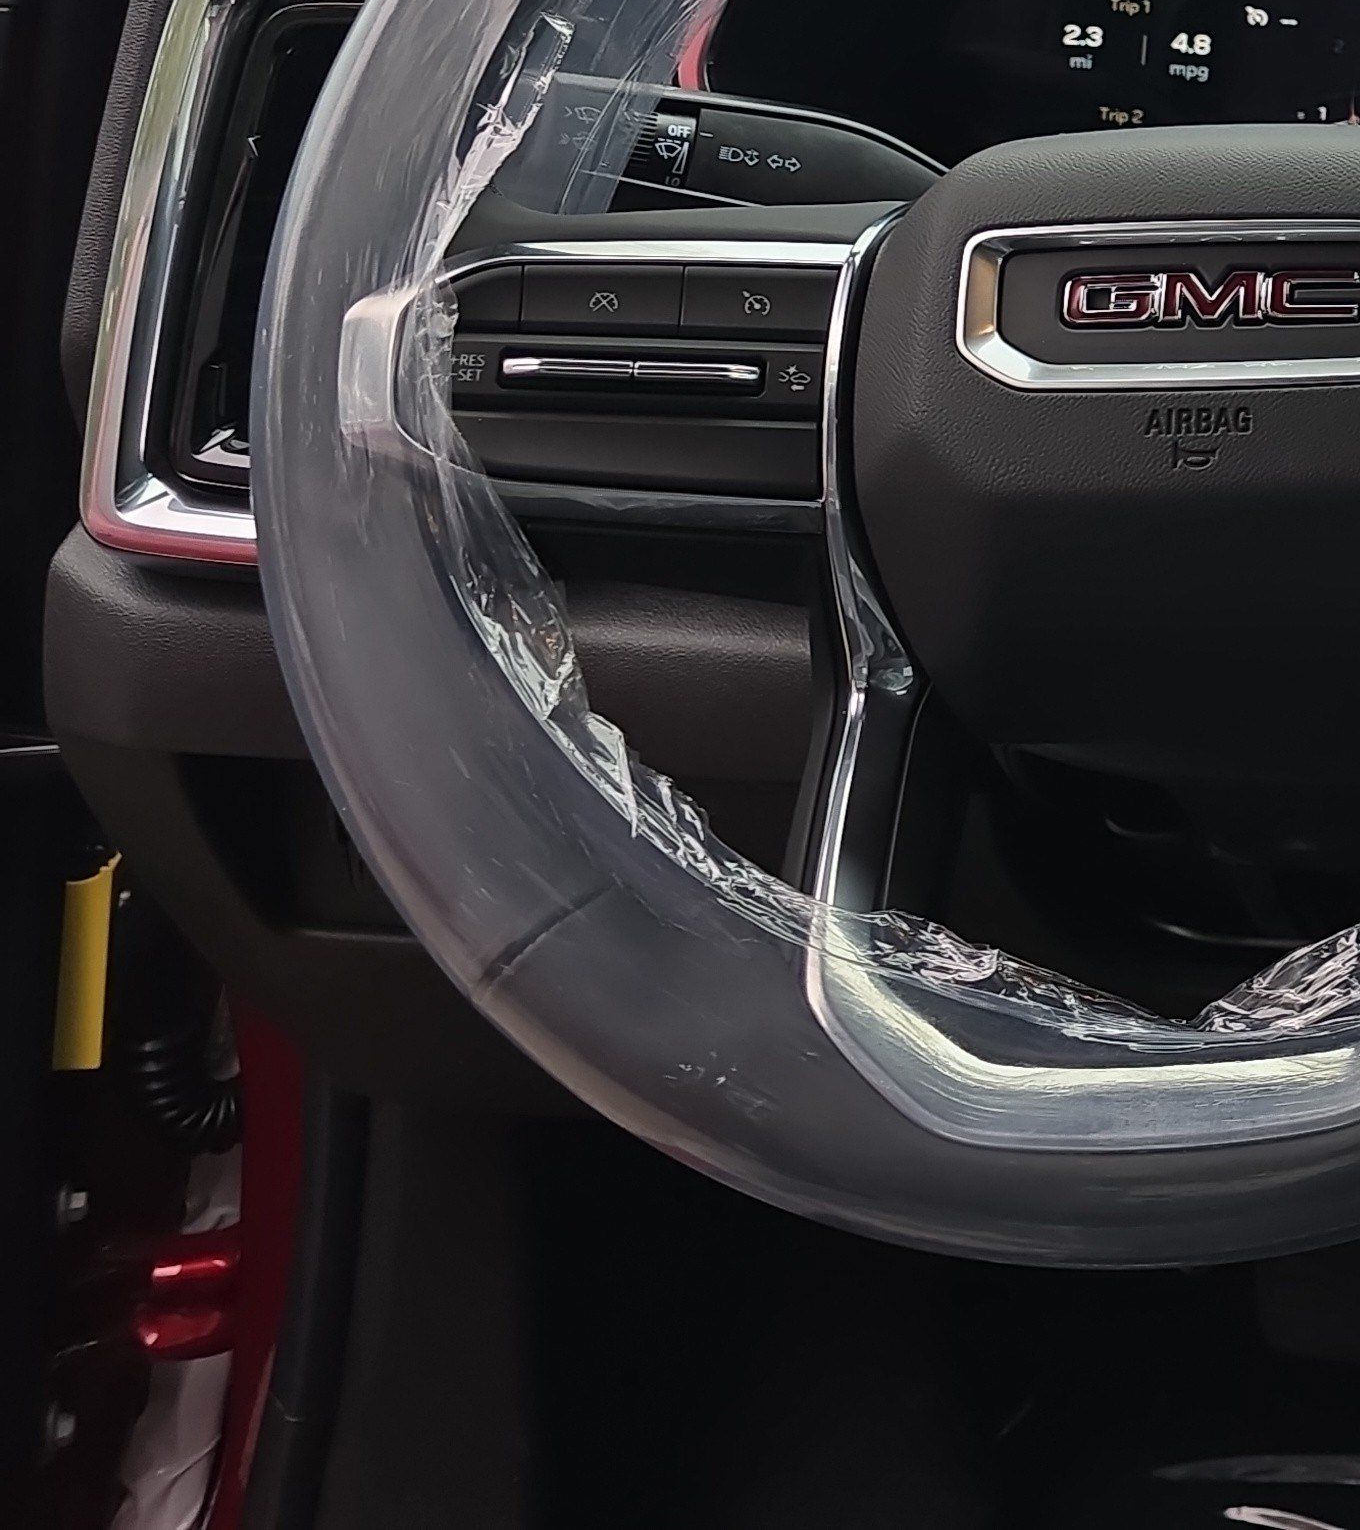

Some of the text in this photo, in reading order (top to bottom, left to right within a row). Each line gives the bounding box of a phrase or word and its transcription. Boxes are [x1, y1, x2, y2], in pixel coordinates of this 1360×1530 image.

[1143, 0, 1151, 14] 1
[1062, 24, 1104, 48] 2.3
[1170, 32, 1212, 56] 4.8
[1069, 54, 1093, 70] mi
[1168, 64, 1209, 82] mpg
[1099, 106, 1144, 126] Trip 2
[667, 124, 692, 138] OFF
[1063, 271, 1360, 325] GMC
[1144, 407, 1254, 437] AIRBAG
